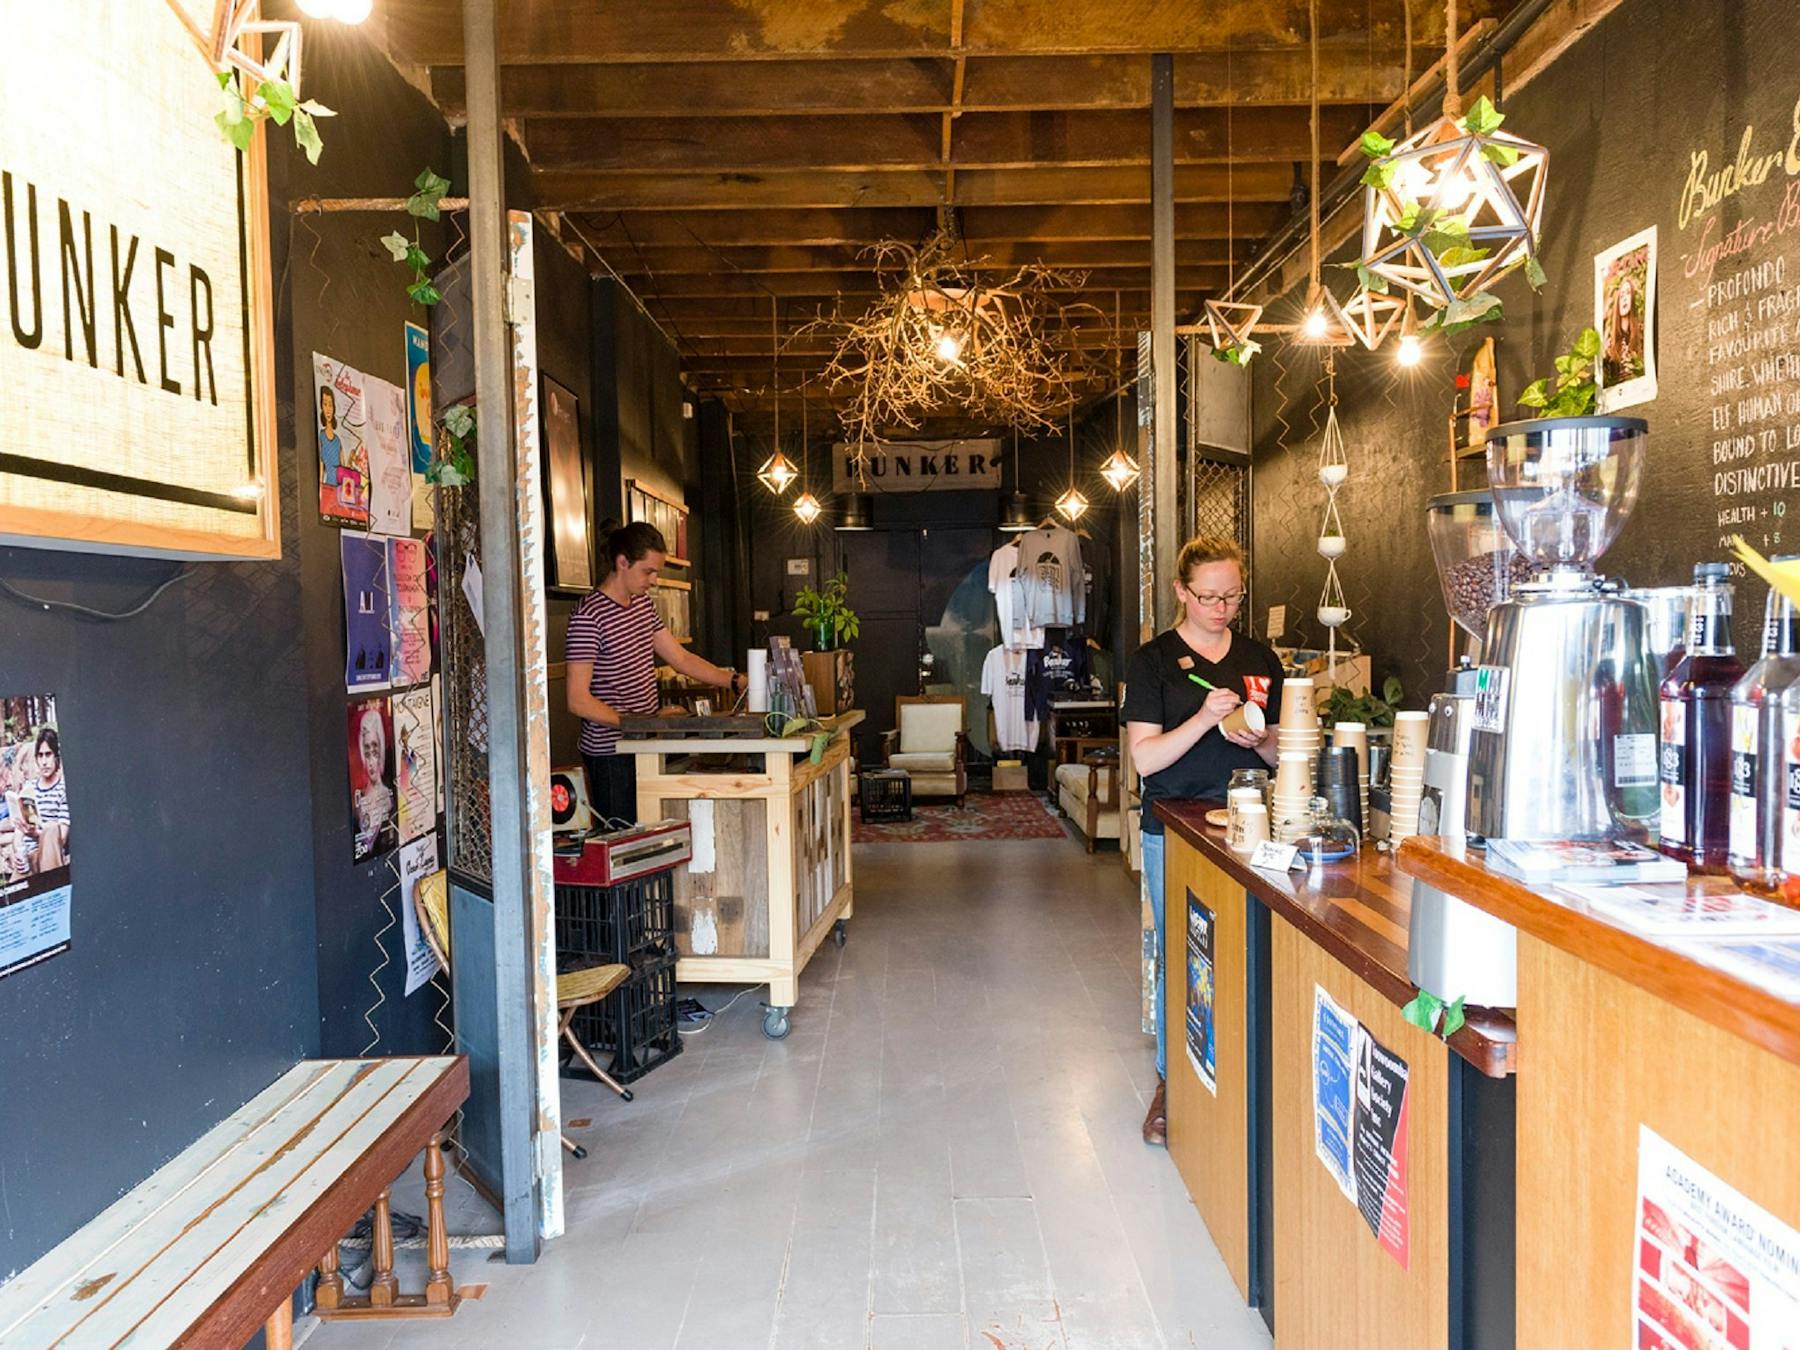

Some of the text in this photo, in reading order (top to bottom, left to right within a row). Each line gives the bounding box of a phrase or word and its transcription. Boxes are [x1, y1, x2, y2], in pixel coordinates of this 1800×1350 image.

[1679, 125, 1783, 230] Bunker
[2, 170, 217, 406] UNKER
[1708, 255, 1785, 308] PROFONDO
[1708, 310, 1739, 341] RICH
[1708, 322, 1789, 366] FAVOURITE
[1738, 390, 1782, 427] HUMAN
[1713, 434, 1756, 466] BOUND
[1759, 428, 1777, 453] TO
[1714, 461, 1800, 496] DISTINCTIVE
[1718, 506, 1755, 527] HEALTH
[1773, 501, 1787, 517] 10
